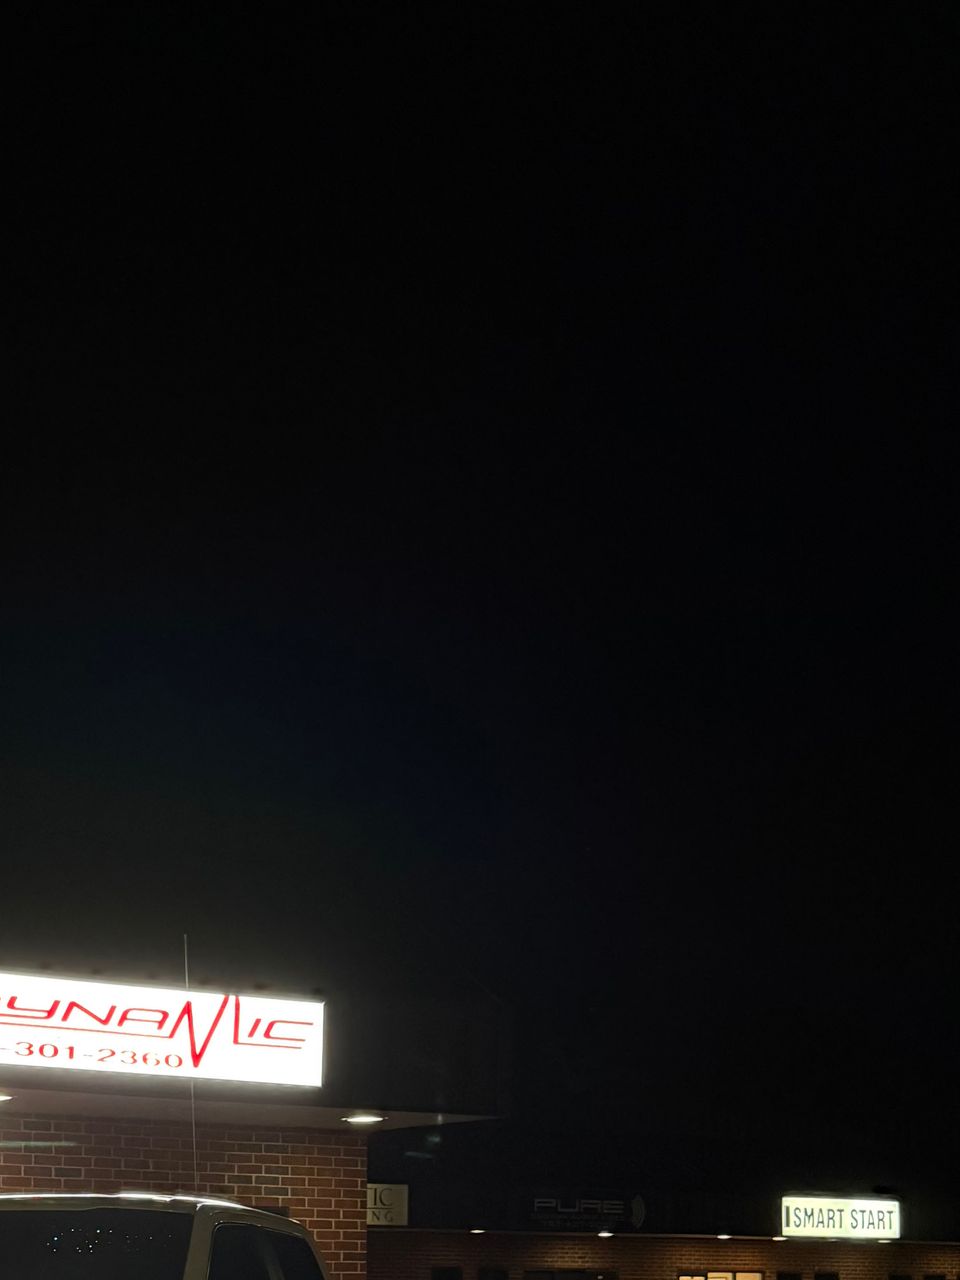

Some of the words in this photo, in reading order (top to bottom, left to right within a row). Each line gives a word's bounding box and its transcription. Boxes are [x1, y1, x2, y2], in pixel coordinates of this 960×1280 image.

[534, 1198, 624, 1214] PURE
[793, 1206, 844, 1229] SMART
[850, 1208, 894, 1231] START
